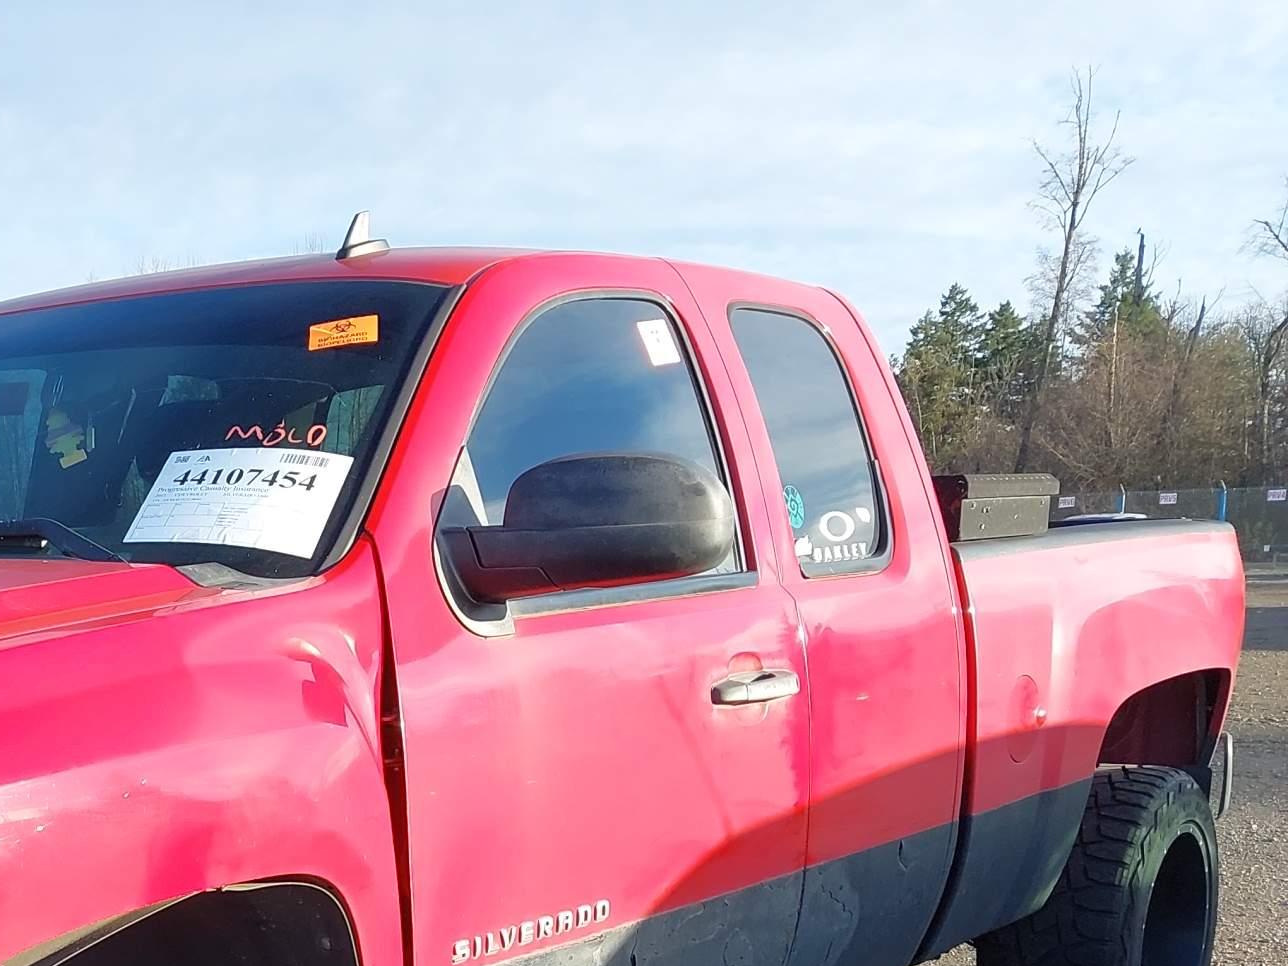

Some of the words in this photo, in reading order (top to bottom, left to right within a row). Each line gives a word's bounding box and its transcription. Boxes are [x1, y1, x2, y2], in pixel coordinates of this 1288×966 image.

[173, 468, 318, 491] 44107454
[813, 542, 868, 563] OAKLEY
[452, 899, 611, 966] SILVERADO
